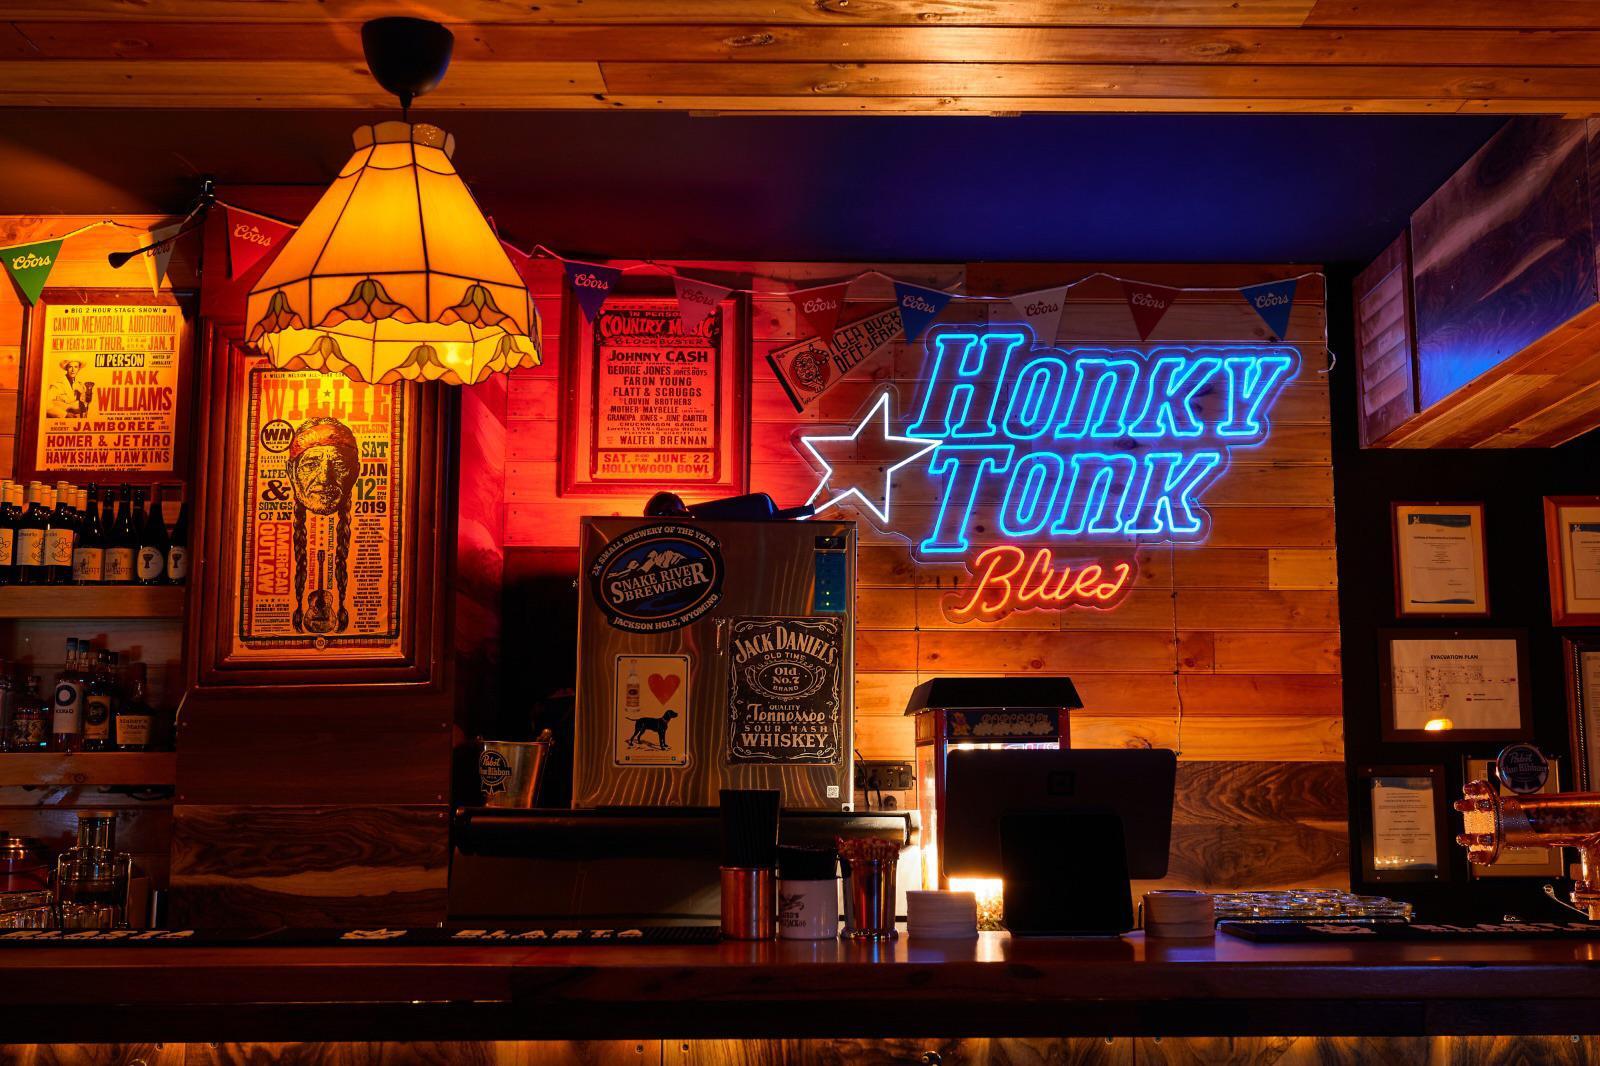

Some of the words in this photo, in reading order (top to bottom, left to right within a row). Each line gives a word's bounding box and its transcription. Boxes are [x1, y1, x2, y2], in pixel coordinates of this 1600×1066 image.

[233, 224, 272, 247] Coors
[12, 253, 52, 270] Coors
[574, 274, 609, 290] Coors
[681, 288, 715, 306] Coors
[902, 295, 936, 313] Coors
[1131, 292, 1166, 309] Coors
[1255, 292, 1289, 308] Coors
[803, 298, 838, 313] Coors
[1024, 300, 1058, 317] Coors
[53, 317, 79, 332] CANTON
[82, 316, 124, 333] MEMORIAL
[128, 315, 176, 333] AUDITORIUM
[601, 314, 666, 337] COUNTRY
[52, 338, 64, 350] NEW
[99, 337, 124, 350] THUR.
[148, 336, 168, 350] JAN.
[170, 336, 175, 350] 1
[834, 342, 865, 374] BEEF
[868, 318, 902, 351] JERKY
[96, 354, 104, 366] IN
[106, 354, 144, 367] PERSON
[609, 351, 661, 362] JOHNNY
[665, 351, 708, 362] CASH
[112, 371, 159, 385] HANK
[608, 366, 640, 375] GEORGE
[643, 366, 671, 375] JONES
[624, 377, 655, 386] FARON
[660, 377, 692, 386] YOUNG
[613, 387, 640, 396] FLATT
[644, 388, 650, 396] &
[656, 388, 702, 396] SCRUGGS
[97, 387, 173, 412] WILLIAMS
[263, 378, 390, 422] WILLIE
[683, 414, 708, 422] CARTER
[74, 422, 156, 432] JAMBOREE
[264, 428, 291, 440] WN
[352, 424, 388, 434] NELSON
[46, 435, 92, 447] HOMER
[98, 436, 108, 446] &
[114, 434, 170, 447] JETHRO
[620, 436, 654, 444] WALTER
[660, 436, 707, 445] BRENNAN
[46, 452, 108, 464] HAWKSHAW
[114, 451, 170, 464] HAWKINS
[362, 442, 388, 458] SAT
[604, 454, 631, 463] SAT.
[654, 454, 686, 463] JUNE
[694, 454, 710, 463] 22
[260, 470, 286, 479] LIFE
[360, 463, 388, 476] JAN
[602, 464, 673, 473] HOLLYWOOD
[677, 464, 710, 473] BOWL
[262, 480, 291, 501] &
[356, 478, 376, 500] 12
[258, 502, 292, 510] SONGS
[354, 502, 387, 513] 2019
[258, 512, 273, 520] OF
[276, 512, 292, 520] AN
[624, 526, 662, 544] BREWERY
[677, 526, 694, 536] THE
[695, 532, 716, 548] YEAR
[258, 524, 275, 592] OUTLAW
[275, 524, 290, 594] AMERICAN
[610, 574, 658, 604] SNAKE
[660, 562, 710, 584] RIVER
[952, 545, 1130, 614] Blues
[624, 577, 692, 602] BREWING
[614, 616, 654, 630] JACKSON
[655, 619, 680, 630] HOLE,
[680, 593, 718, 623] WYOMING
[735, 633, 775, 663] JACK
[776, 626, 838, 664] DANIEL'S
[764, 652, 782, 660] OLD
[785, 652, 806, 660] TIME
[774, 667, 797, 676] Old
[746, 704, 826, 722] Tennessee
[741, 733, 828, 748] WHISKEY
